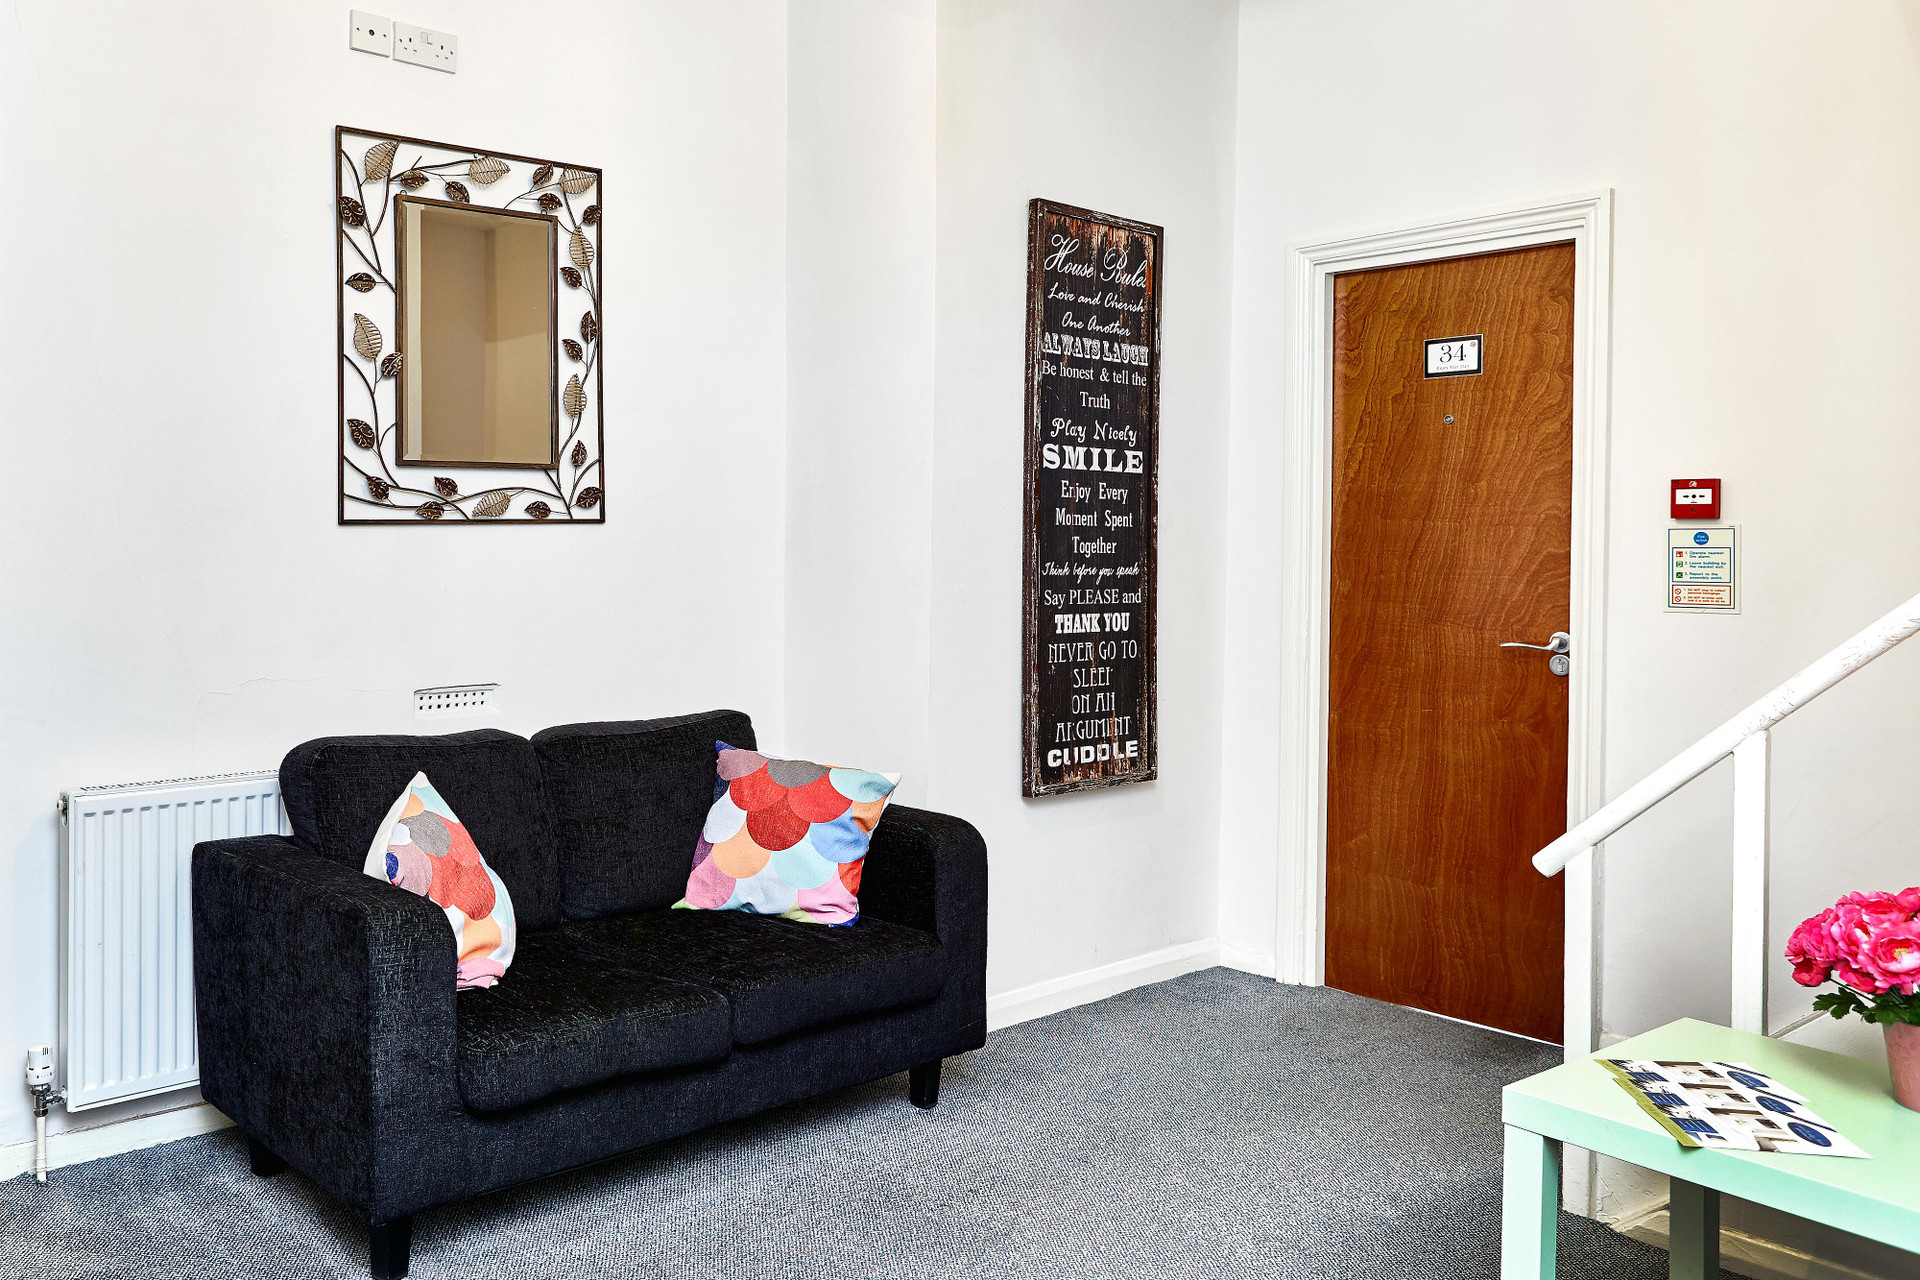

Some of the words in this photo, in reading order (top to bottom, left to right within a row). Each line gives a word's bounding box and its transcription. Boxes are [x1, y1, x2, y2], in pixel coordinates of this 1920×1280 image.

[1044, 234, 1093, 278] House
[1048, 282, 1075, 300] Love
[1078, 292, 1101, 306] and
[1104, 293, 1144, 313] Cherish
[1061, 311, 1084, 329] One
[1087, 315, 1131, 337] Another
[1042, 332, 1100, 360] ALWAYS
[1102, 341, 1149, 367] LAUGH
[1439, 343, 1467, 363] 34
[1042, 360, 1057, 376] Be
[1060, 362, 1095, 381] honest
[1100, 367, 1110, 383] &
[1113, 370, 1129, 385] tell
[1132, 371, 1147, 387] the
[1080, 391, 1111, 410] Truth
[1050, 417, 1087, 443] Play
[1093, 420, 1138, 447] Nicely
[1042, 443, 1144, 474] SMILE
[1061, 480, 1091, 503] Enjoy
[1099, 482, 1128, 505] Every
[1055, 507, 1098, 527] Moment
[1104, 509, 1133, 531] Spent
[1072, 536, 1117, 558] Together
[1042, 561, 1070, 576] Think
[1073, 562, 1097, 584] before
[1096, 567, 1114, 585] you
[1116, 561, 1140, 578] speak
[1044, 589, 1066, 609] Say
[1068, 588, 1120, 605] PLEASE
[1122, 588, 1142, 604] and
[1055, 613, 1101, 634] THANK
[1103, 612, 1130, 632] YOU
[1048, 641, 1094, 663] NEVER
[1098, 641, 1117, 660] GO
[1121, 639, 1138, 659] TO
[1071, 694, 1091, 715] ON
[1094, 691, 1116, 712] AN
[1047, 740, 1139, 768] CUDDLE
